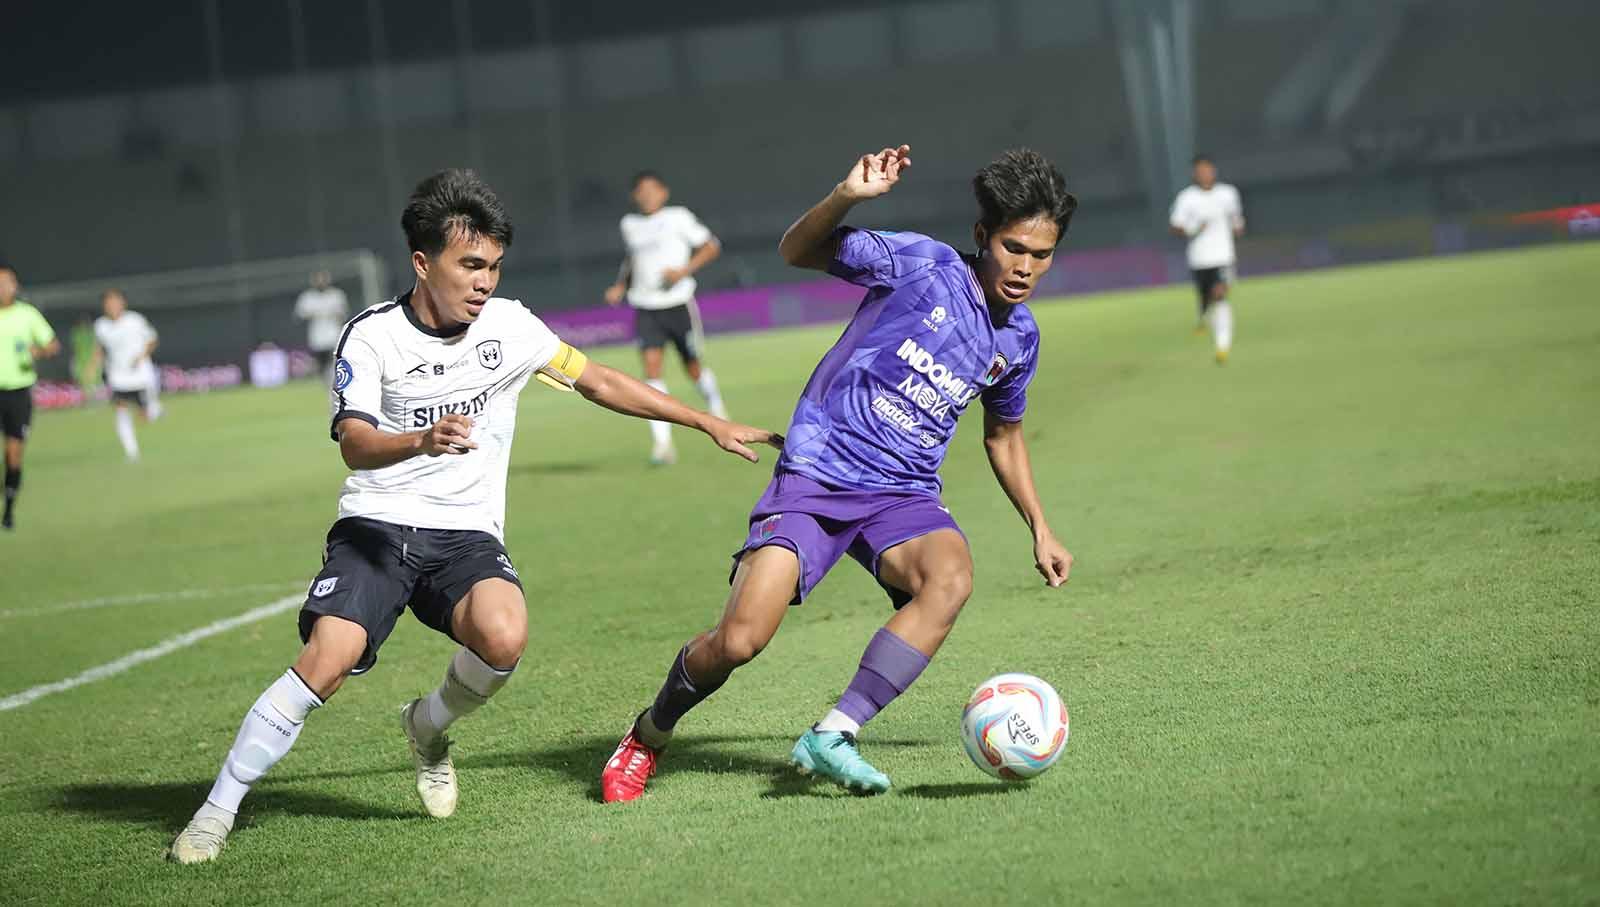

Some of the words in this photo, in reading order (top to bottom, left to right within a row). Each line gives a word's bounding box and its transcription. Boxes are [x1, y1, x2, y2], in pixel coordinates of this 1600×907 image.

[896, 338, 975, 408] INDOMILK
[897, 373, 951, 422] MOYA
[1010, 712, 1040, 745] SPECS
